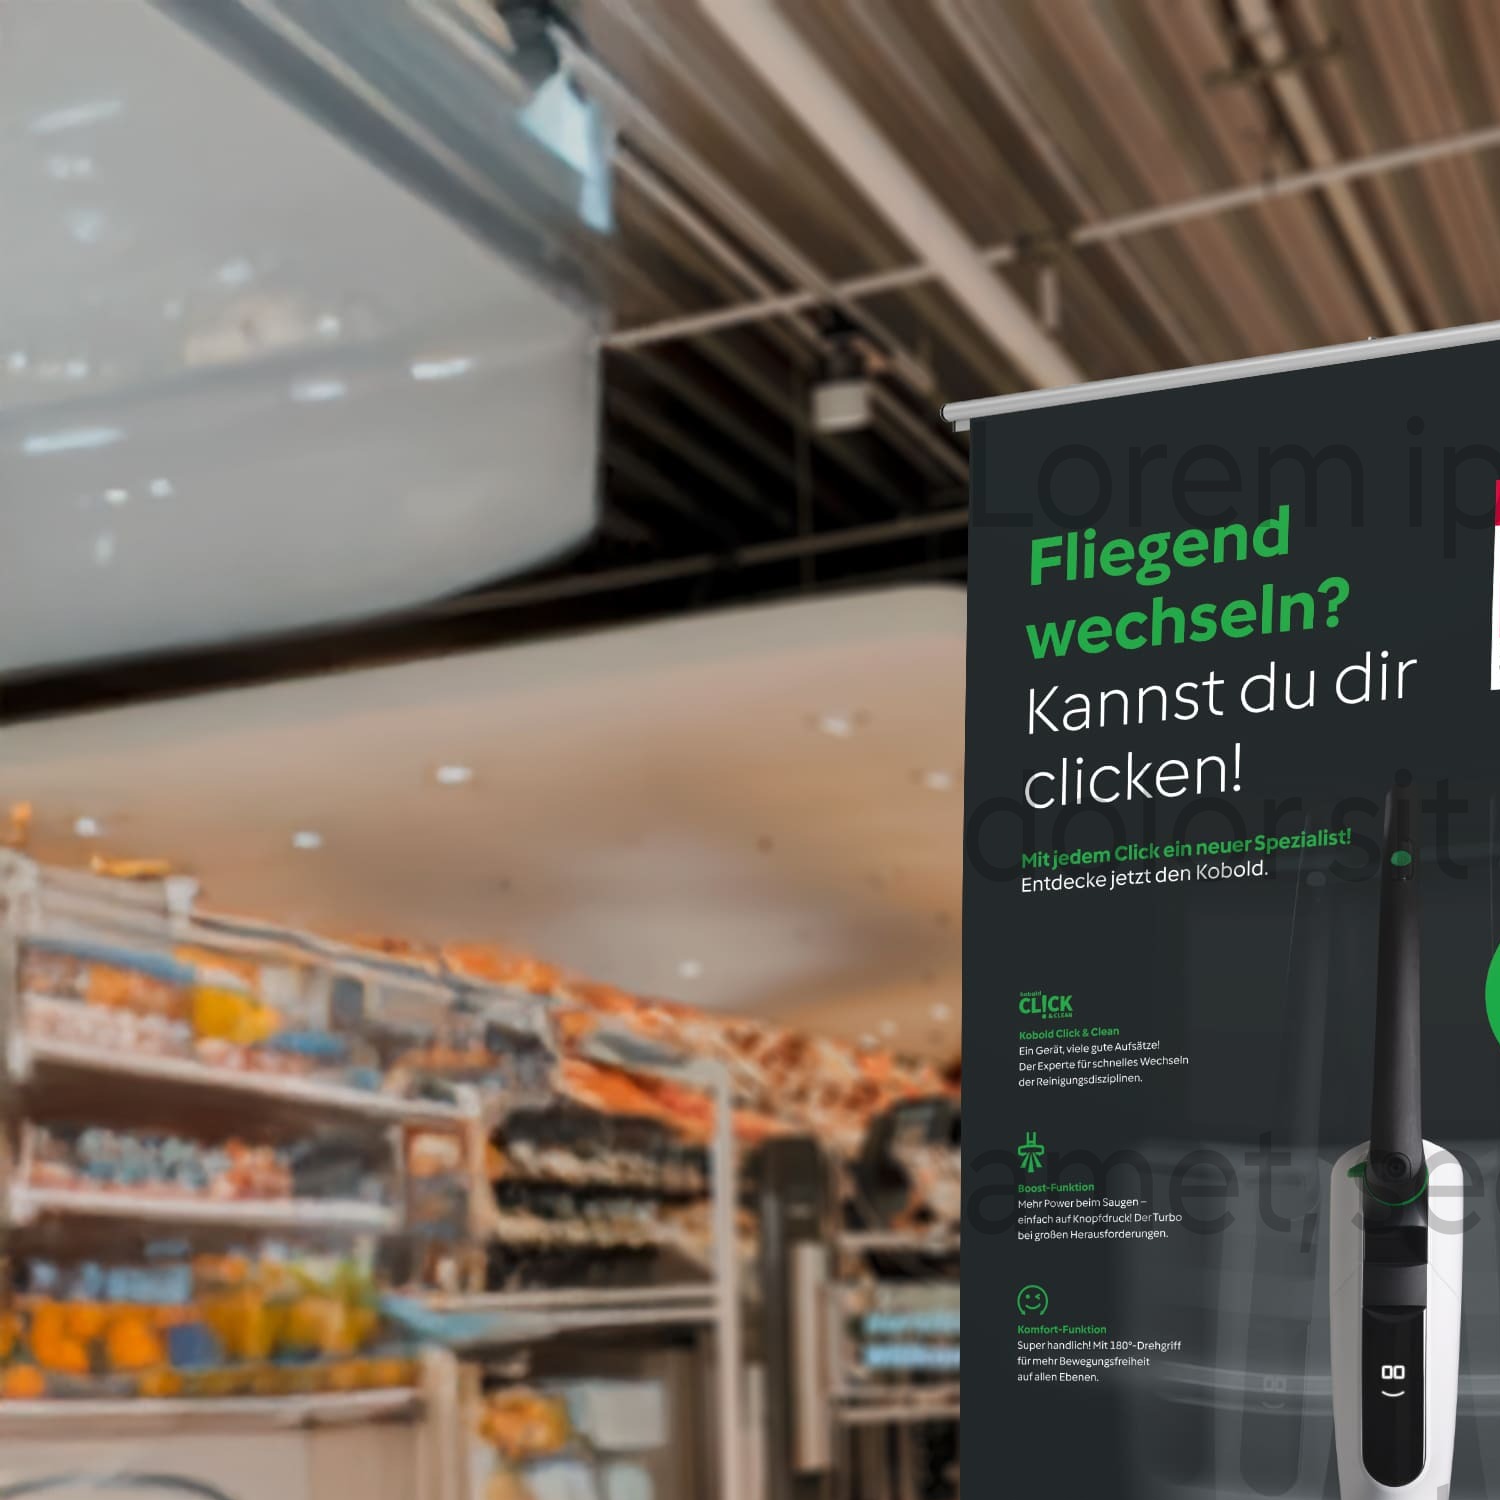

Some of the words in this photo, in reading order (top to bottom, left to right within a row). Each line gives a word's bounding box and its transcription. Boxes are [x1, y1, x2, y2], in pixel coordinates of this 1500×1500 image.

[1029, 504, 1290, 587] Fliegend
[1026, 576, 1350, 660] wechseln?
[1028, 669, 1225, 735] Kannst
[1239, 661, 1315, 713] du
[1335, 650, 1418, 705] dir
[1024, 742, 1242, 810] clicken!
[1022, 851, 1049, 869] Mit
[1052, 849, 1110, 870] jedem
[1115, 843, 1160, 861] Click
[1164, 841, 1192, 858] ein
[1196, 839, 1252, 855] neuer
[1254, 828, 1351, 854] Spezialist!
[1022, 872, 1106, 892] Entdecke
[1110, 869, 1151, 890] jetzt
[1155, 866, 1190, 883] den
[1197, 859, 1268, 880] Kobold.
[1019, 1032, 1054, 1040] Kobold
[1056, 1029, 1080, 1038] Click
[1083, 1029, 1089, 1037] &
[1091, 1027, 1119, 1036] Clean
[1019, 1047, 1033, 1056] Ein
[1036, 1046, 1065, 1055] Gerät,
[1066, 1044, 1089, 1053] viele
[1091, 1043, 1113, 1054] gute
[1115, 1040, 1160, 1051] Aufsätze!
[1019, 1062, 1036, 1071] Der
[1037, 1061, 1075, 1071] Experte
[1077, 1060, 1091, 1068] für
[1093, 1058, 1138, 1067] schnelles
[1140, 1056, 1189, 1066] Wechseln
[1018, 1078, 1035, 1086] der
[1036, 1074, 1142, 1087] Reinigungsdisziplinen.
[1018, 1183, 1095, 1193] Boost-Funktion
[1018, 1200, 1042, 1209] Mehr
[1044, 1199, 1074, 1208] Power
[1076, 1198, 1100, 1207] beim
[1102, 1198, 1138, 1208] Saugen
[1018, 1215, 1053, 1224] einfach
[1055, 1215, 1071, 1223] auf
[1073, 1214, 1132, 1224] Knopfdruck!
[1134, 1213, 1151, 1222] Der
[1153, 1213, 1182, 1222] Turbo
[1018, 1231, 1033, 1240] bei
[1034, 1230, 1068, 1241] großen
[1070, 1229, 1168, 1240] Herausforderungen.
[1018, 1325, 1107, 1334] Komfort-Funktion
[1017, 1341, 1046, 1351] Super
[1047, 1340, 1091, 1350] handlich!
[1093, 1341, 1108, 1349] Mit
[1110, 1341, 1182, 1352] 180°-Drehgriff
[1017, 1357, 1031, 1365] für
[1033, 1357, 1057, 1365] mehr
[1059, 1356, 1150, 1368] Bewegungsfreiheit
[1017, 1372, 1033, 1381] auf
[1035, 1373, 1057, 1381] allen
[1059, 1373, 1099, 1381] Ebenen.
